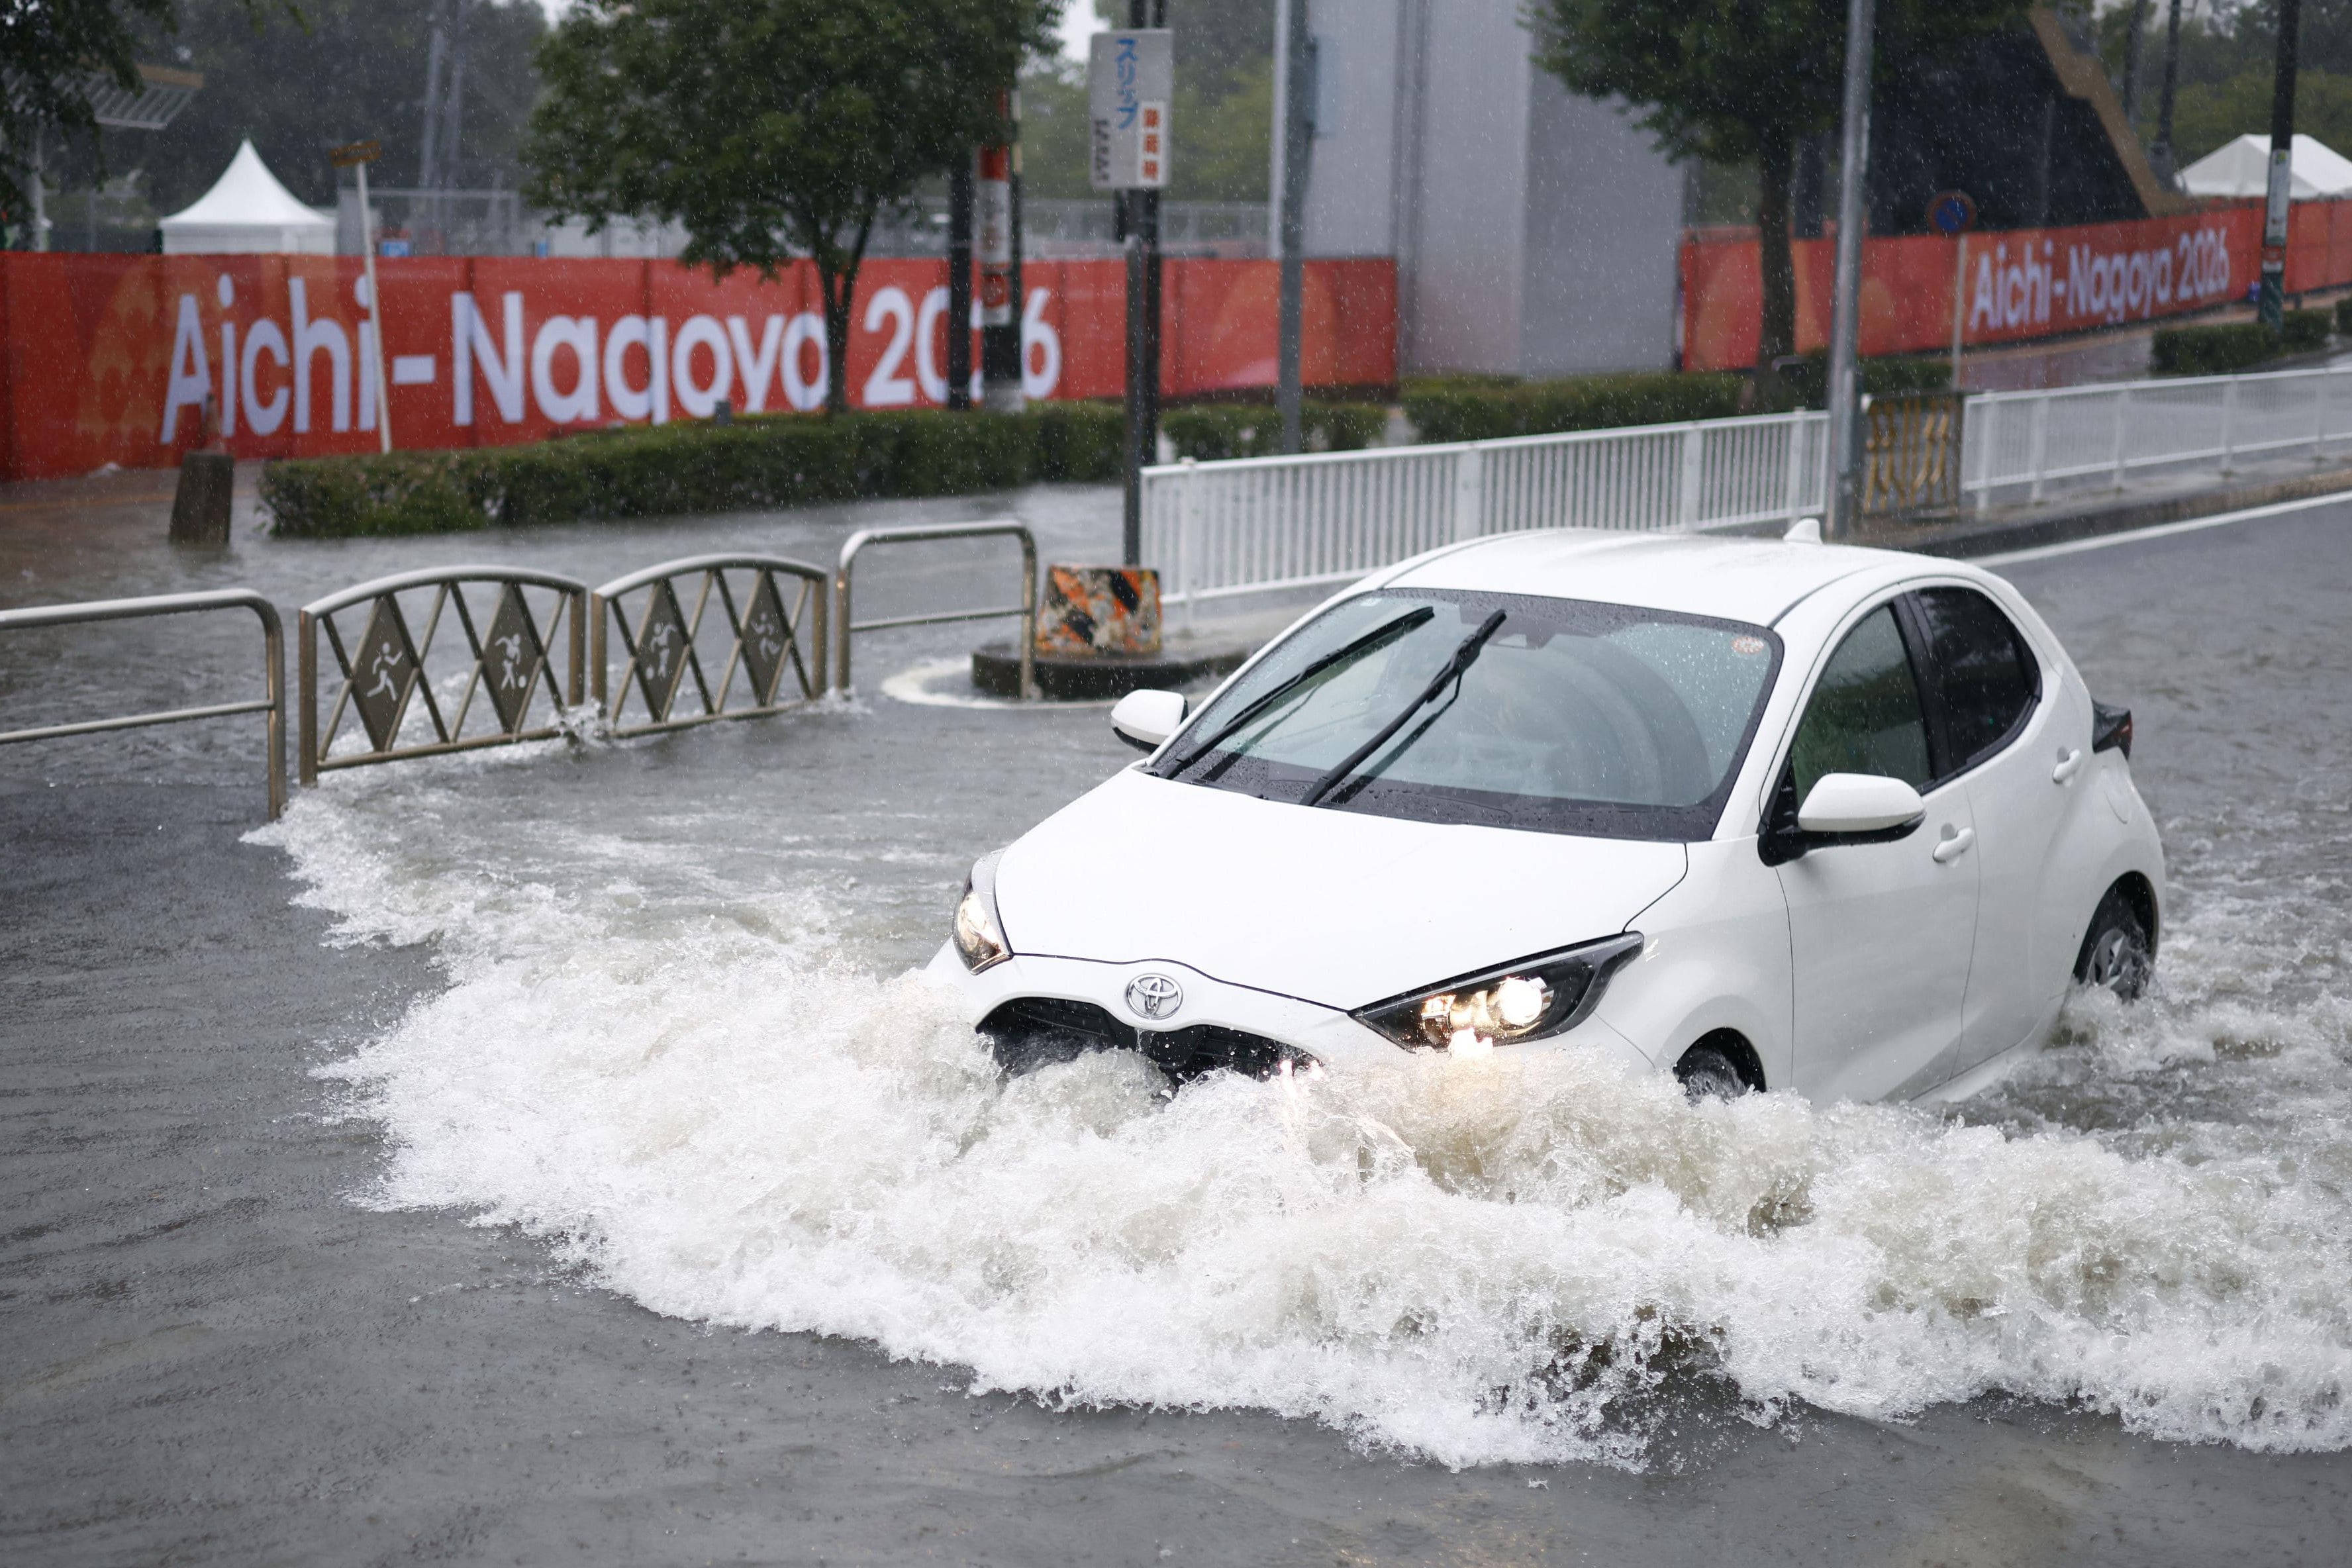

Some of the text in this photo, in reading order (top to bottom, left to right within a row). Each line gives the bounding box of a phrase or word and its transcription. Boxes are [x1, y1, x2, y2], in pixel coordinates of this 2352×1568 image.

[1969, 227, 2230, 331] Aichi-Nagoya 2026
[160, 273, 1062, 445] Aichi-Nagoya 206
